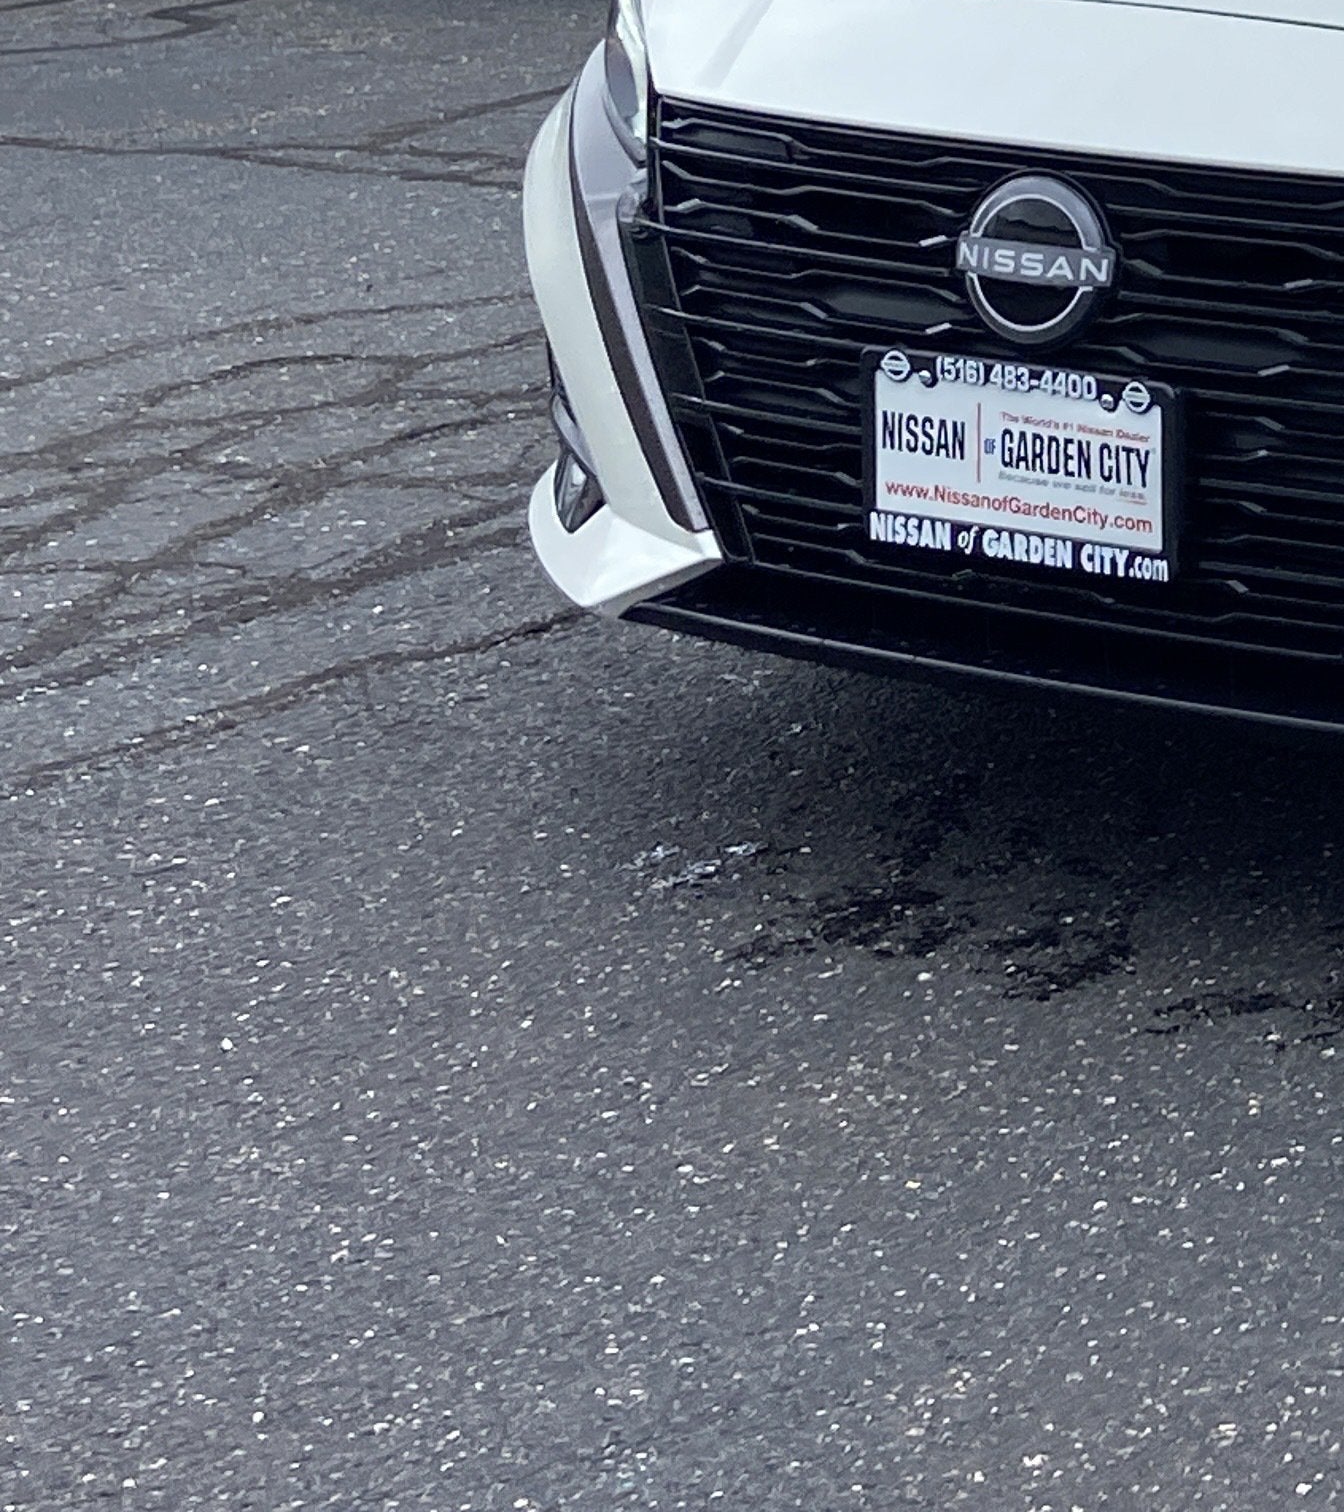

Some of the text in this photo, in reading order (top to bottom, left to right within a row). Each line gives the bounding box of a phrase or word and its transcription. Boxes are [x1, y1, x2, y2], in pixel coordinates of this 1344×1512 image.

[958, 241, 1109, 282] NISSAN
[935, 355, 1097, 401] (516) 483-4400
[881, 410, 965, 460] NISSAN
[984, 439, 997, 455] OF
[1001, 428, 1150, 488] GARDEN CITY
[885, 481, 1153, 534] www.NissanofGardenCity.com
[869, 511, 1169, 582] NISSAN of GARDEN CITY.com
